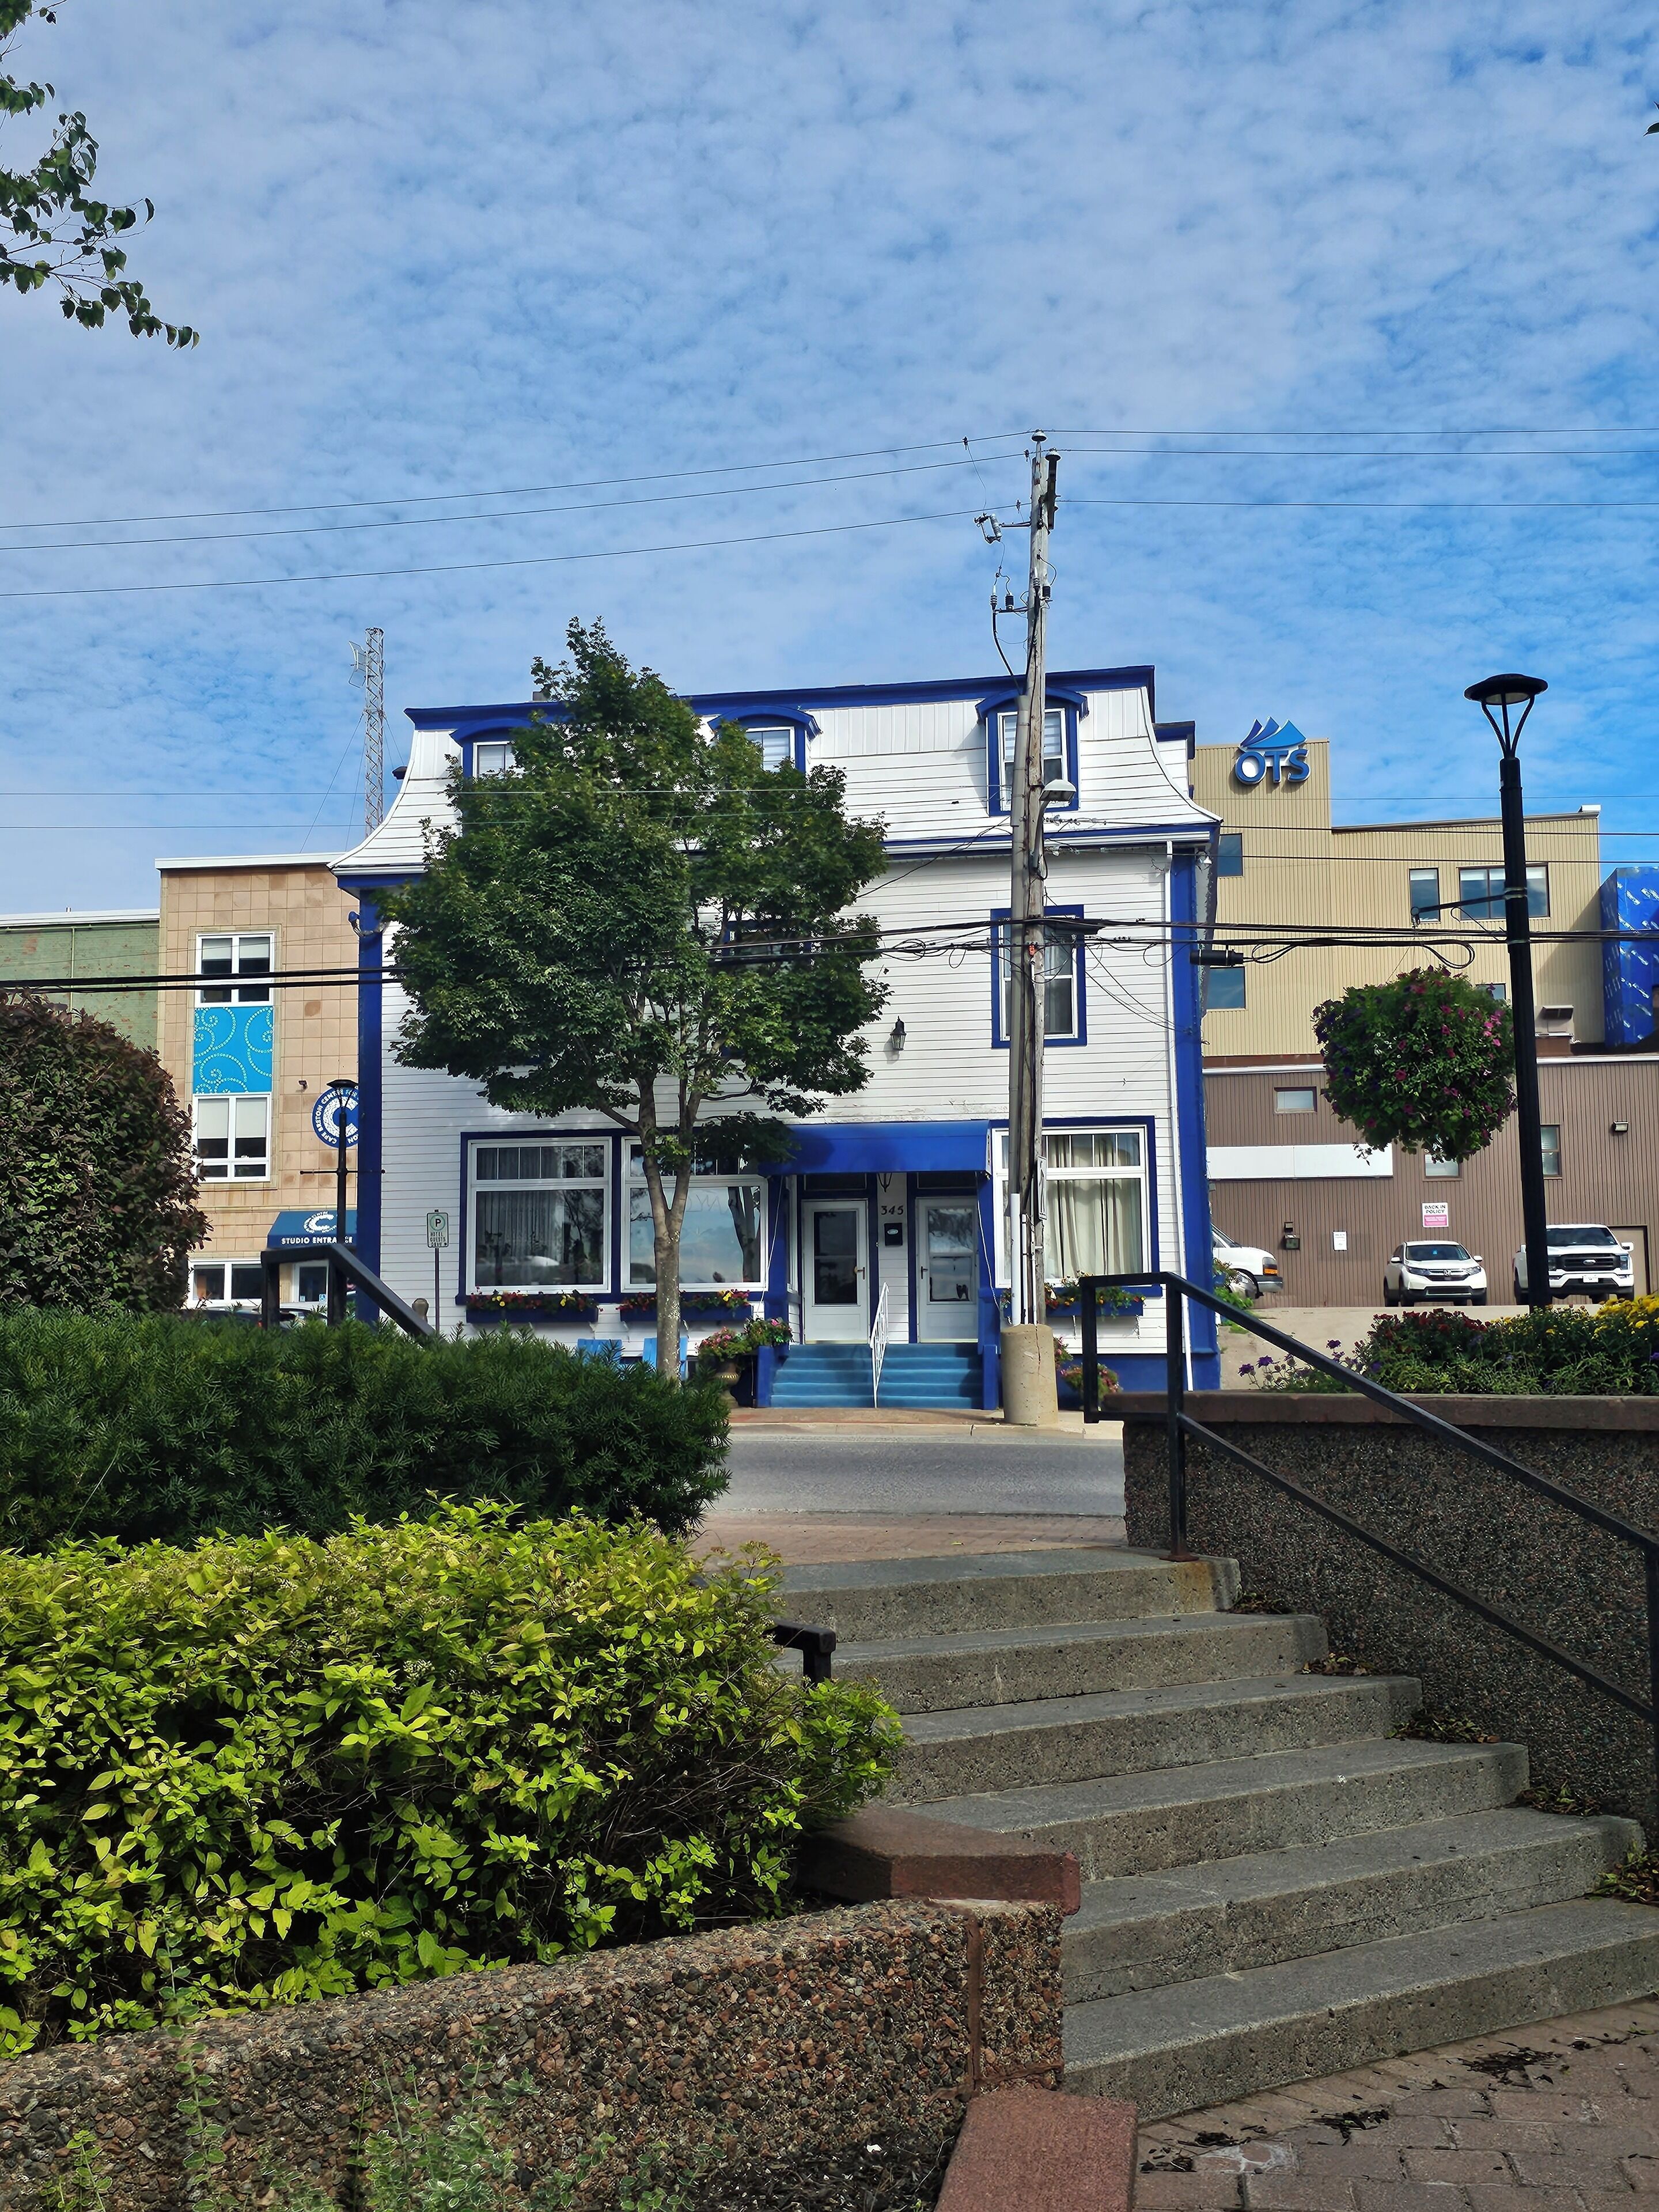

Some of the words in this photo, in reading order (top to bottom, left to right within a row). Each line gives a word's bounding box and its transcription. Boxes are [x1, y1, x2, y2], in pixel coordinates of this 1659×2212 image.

[1236, 748, 1310, 784] OTS
[315, 1105, 323, 1132] BRETON
[881, 1205, 904, 1215] 345
[435, 1218, 441, 1227] P
